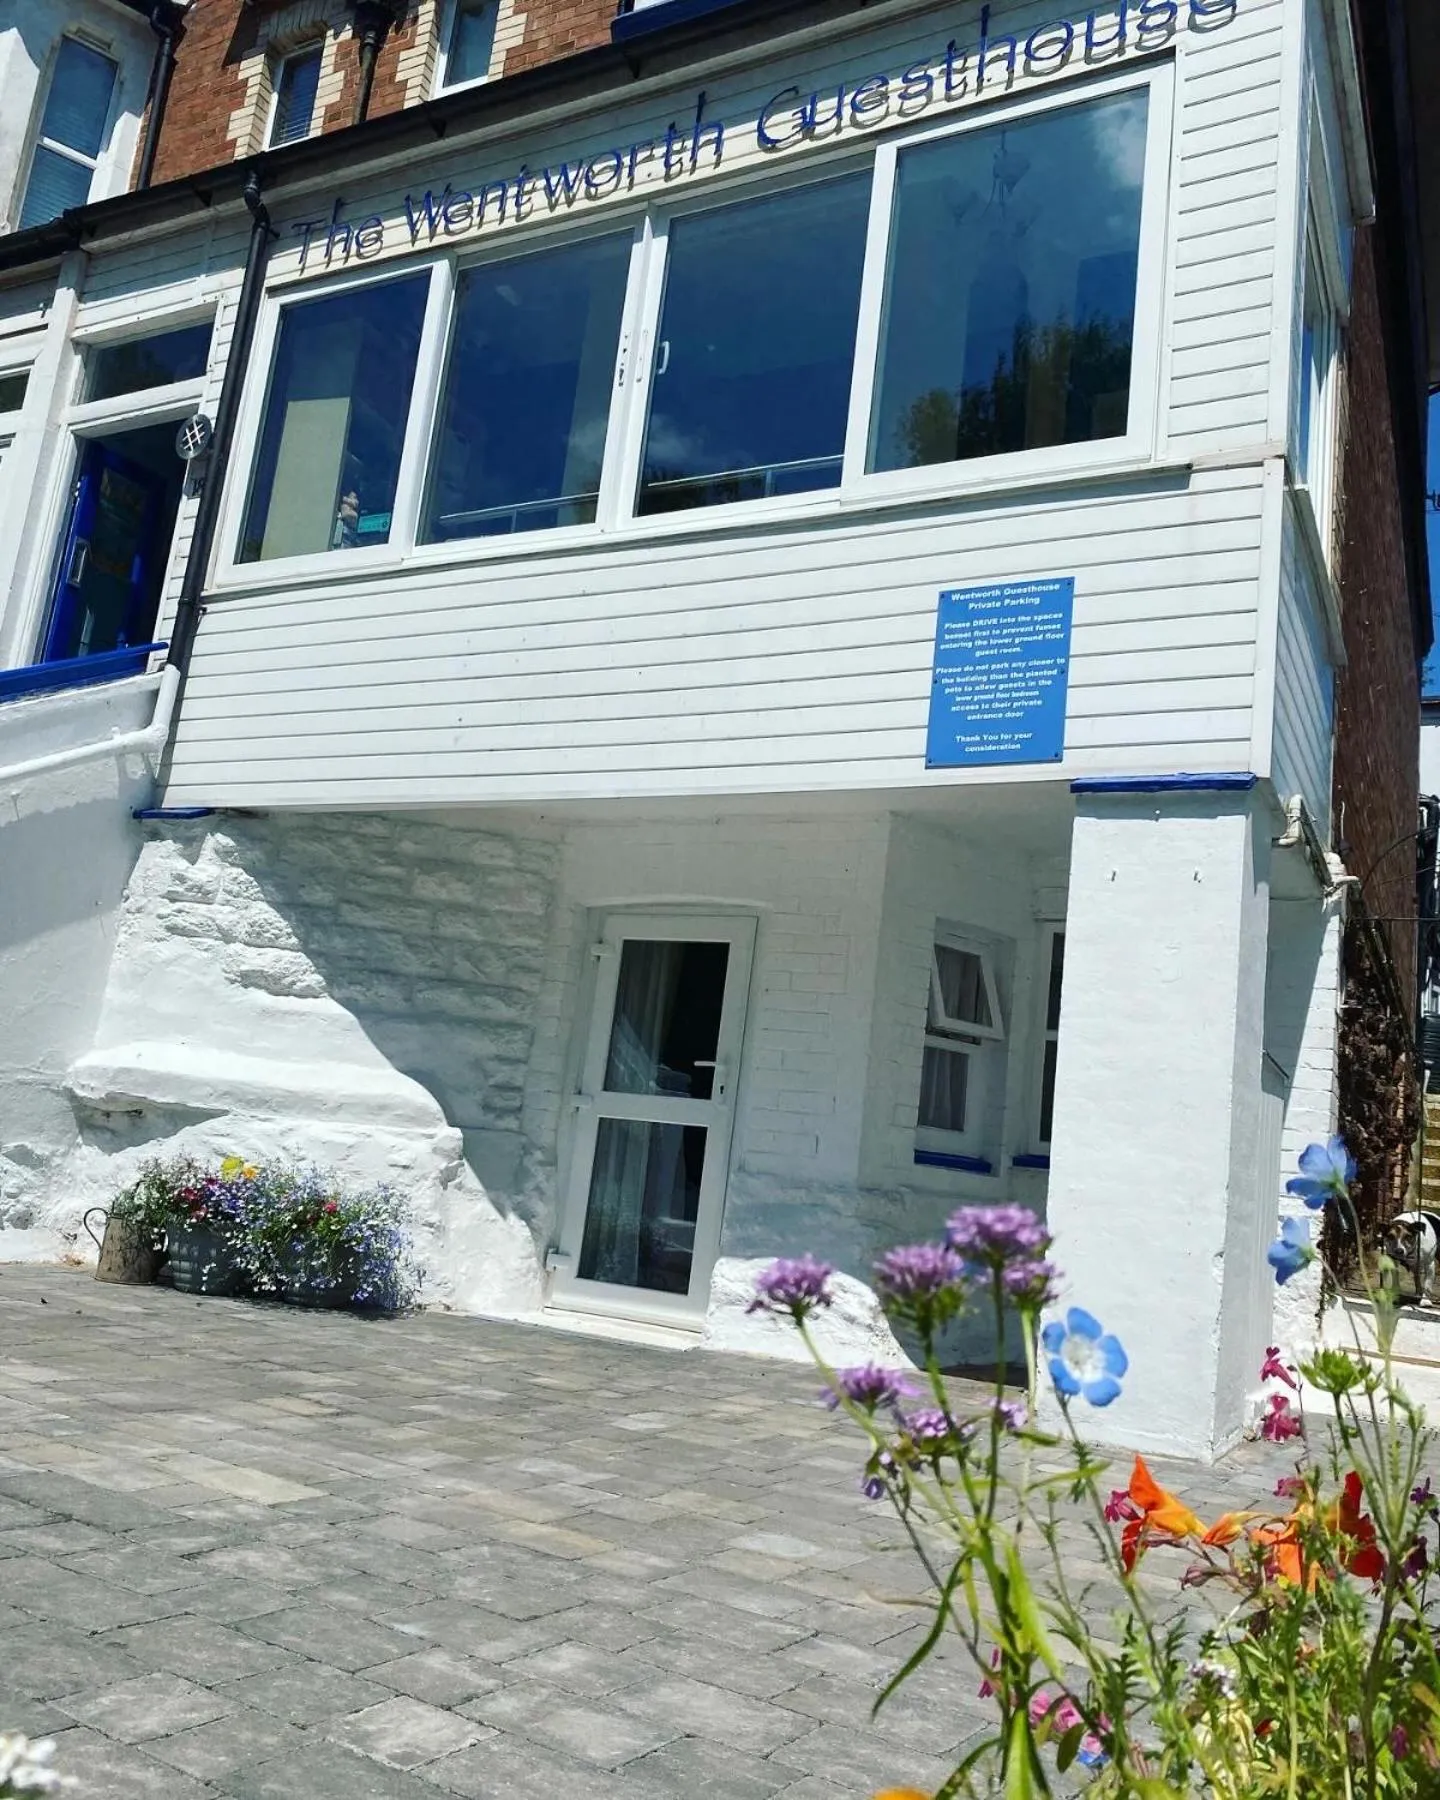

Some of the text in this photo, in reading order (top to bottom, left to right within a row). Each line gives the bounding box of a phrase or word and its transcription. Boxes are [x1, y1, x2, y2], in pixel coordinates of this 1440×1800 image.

[291, 198, 385, 264] The
[403, 91, 726, 246] Wentworth
[951, 583, 1060, 601] Wentworth Guesthouse
[968, 596, 1040, 610] Private Parking
[944, 622, 970, 630] Please
[972, 618, 998, 627] DRIVE
[1018, 614, 1031, 622] the
[973, 630, 990, 638] first
[1002, 626, 1034, 635] prevent
[940, 631, 1065, 651] entering the lower ground floor
[975, 647, 998, 658] guest
[936, 666, 962, 674] Please
[963, 664, 974, 672] do
[975, 663, 989, 671] not
[990, 660, 1009, 670] park
[1011, 659, 1026, 669] any
[1028, 656, 1055, 666] closer
[956, 674, 988, 684] building
[989, 672, 1008, 681] than
[1010, 670, 1024, 679] the
[1025, 668, 1058, 678] planted
[974, 682, 997, 692] allow
[998, 681, 1026, 691] guests
[1038, 679, 1053, 687] the
[974, 692, 994, 702] ground
[995, 691, 1011, 699] floor
[951, 703, 980, 712] access
[991, 700, 1012, 709] their
[1013, 698, 1042, 709] private
[966, 711, 1025, 721] entrance door
[956, 731, 1034, 743] Thank You for your
[964, 742, 1021, 753] consideration
